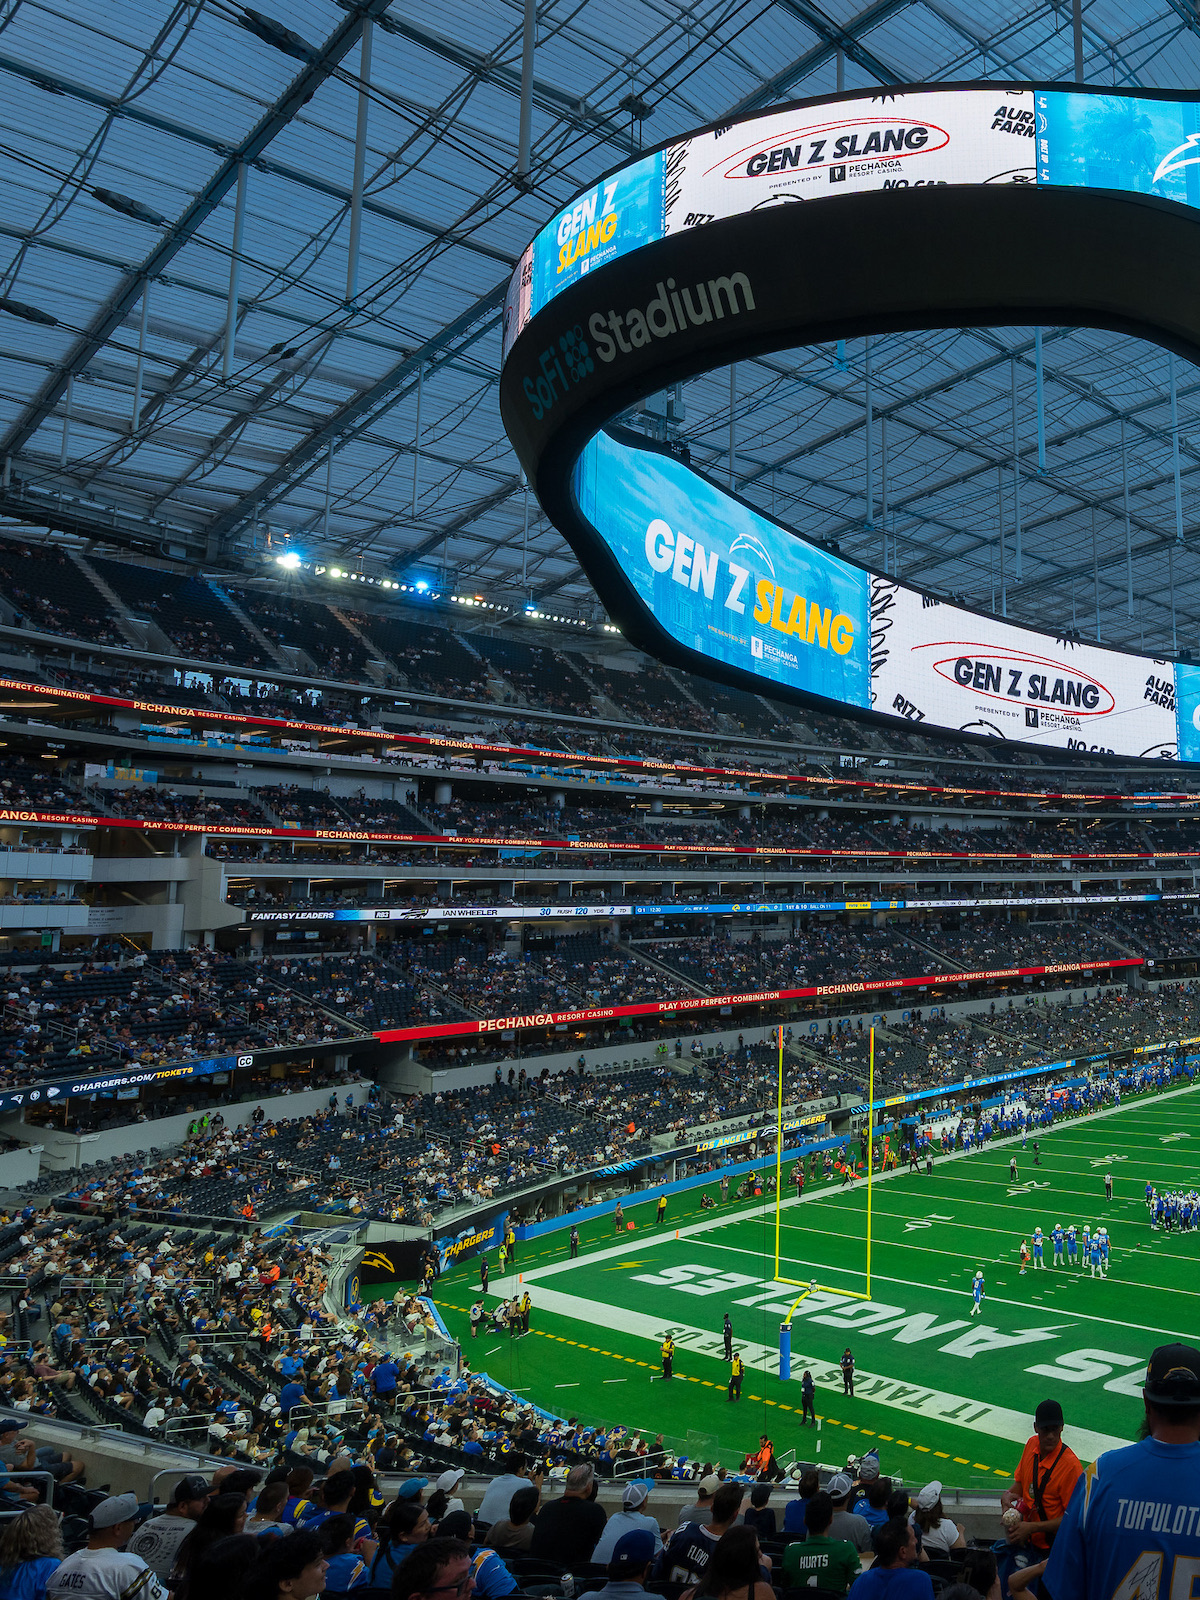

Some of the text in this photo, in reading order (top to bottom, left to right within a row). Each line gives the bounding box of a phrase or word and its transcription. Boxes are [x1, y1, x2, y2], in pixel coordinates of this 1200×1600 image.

[746, 127, 929, 177] GEN Z SLANG
[849, 160, 902, 173] PECHANGA
[849, 170, 875, 178] RESORT
[769, 177, 811, 189] PRESENTED
[557, 180, 620, 246] GEN Z
[683, 212, 716, 226] RIZZ
[557, 213, 618, 274] SLANG
[523, 271, 756, 420] SoFi Stadium
[645, 519, 750, 615] GEN Z
[753, 579, 854, 655] SLANG
[708, 625, 739, 642] PRESENTED
[764, 644, 798, 662] PECHANGA
[954, 658, 1100, 709] GEN Z SLANG
[34, 686, 90, 699] COMBINATION
[133, 702, 195, 716] PECHANGA
[893, 693, 926, 722] RIZZ
[975, 705, 1010, 717] PRESENTED
[1040, 712, 1080, 726] PECHANGA
[352, 730, 394, 739] COMBINATION
[430, 736, 473, 751] PECHANGA
[1067, 737, 1087, 751] NO
[642, 761, 675, 769] PECHANGA
[316, 831, 368, 839] PECHANGA
[251, 911, 335, 920] FANTASY LEADERS
[458, 909, 498, 917] WHEELER
[540, 906, 616, 916] 30 120 2
[1044, 964, 1080, 973] PECHANGA
[816, 983, 864, 994] PECHANGA
[659, 992, 779, 1010] PLAY YOUR PERFECT COMBINATION
[478, 1001, 614, 1030] PECHANGA RESORT CASINO
[239, 1057, 252, 1067] CC
[72, 1066, 194, 1094] CHARGERS.COM/TICKETS
[695, 1113, 827, 1153] LOS ANGELES CHARGERS
[1006, 1180, 1051, 1197] 20
[903, 1213, 955, 1233] 10
[444, 1227, 496, 1258] CHARGERS
[629, 1264, 1080, 1359] ANGELES
[654, 1326, 993, 1423] IT TAKES OF US
[688, 1544, 710, 1565] FLOYD
[799, 1553, 829, 1569] HURTS
[59, 1573, 86, 1589] GATES
